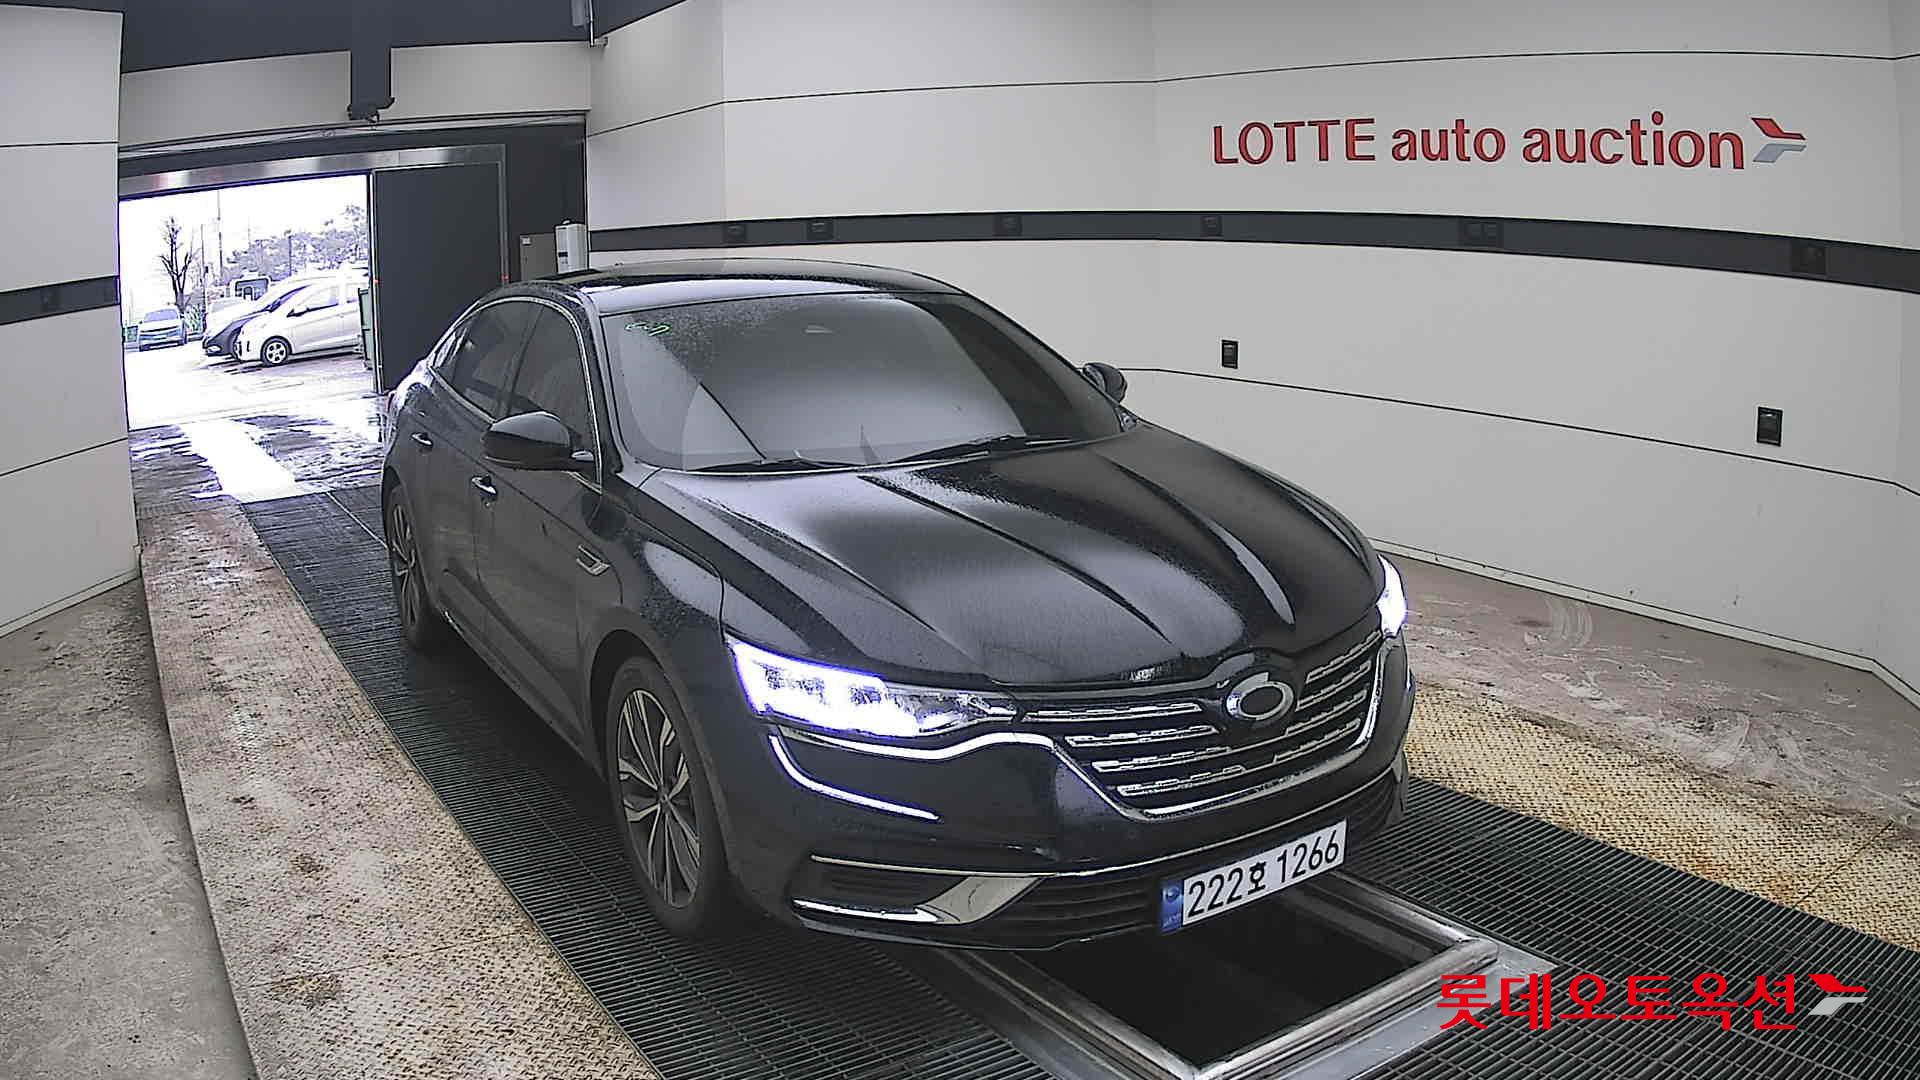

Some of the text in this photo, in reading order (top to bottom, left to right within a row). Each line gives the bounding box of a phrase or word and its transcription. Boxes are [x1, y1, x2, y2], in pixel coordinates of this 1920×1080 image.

[1213, 111, 1745, 169] LOTTE auto auction
[1187, 829, 1340, 918] 222호 1266
